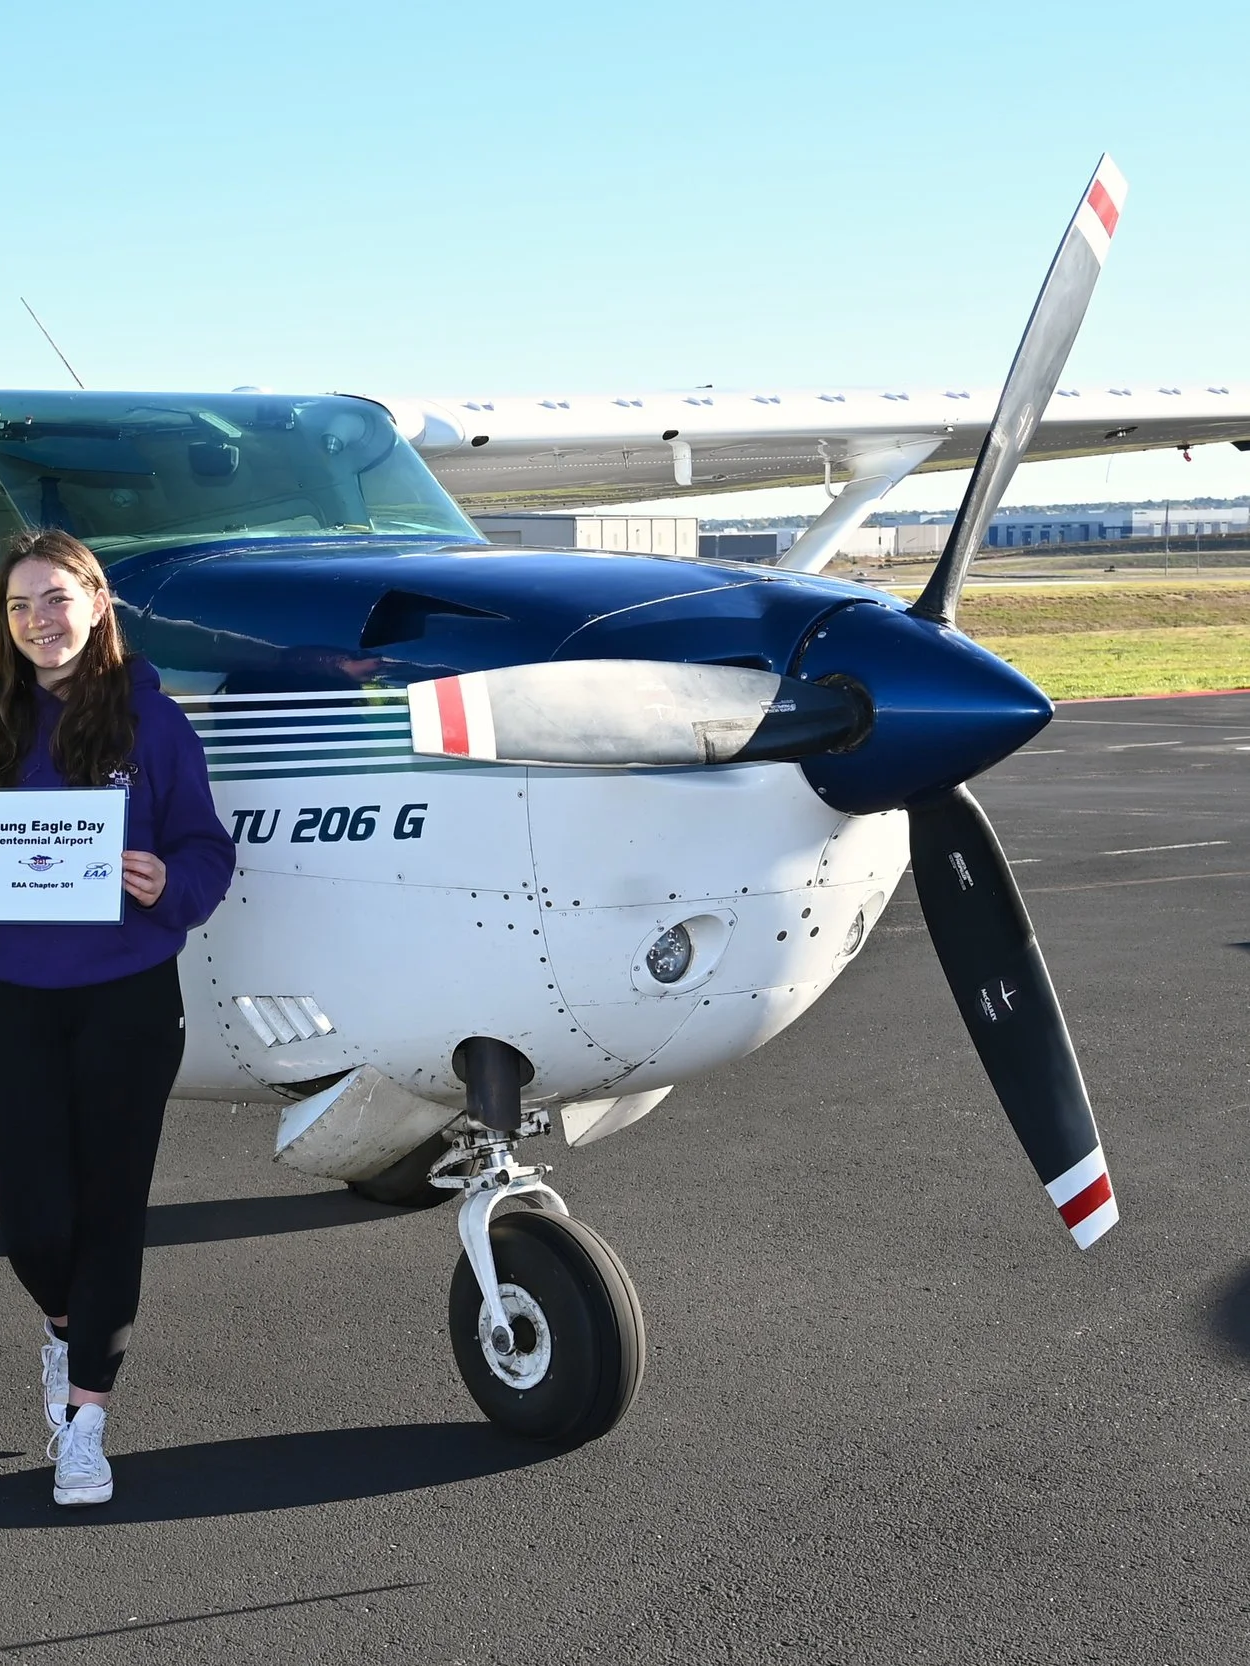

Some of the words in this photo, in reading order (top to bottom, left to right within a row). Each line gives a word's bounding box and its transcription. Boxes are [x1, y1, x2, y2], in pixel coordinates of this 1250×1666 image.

[31, 820, 73, 834] Eagle
[77, 819, 105, 834] Day
[231, 809, 281, 844] TU
[290, 805, 381, 843] 206
[393, 803, 429, 840] G
[54, 836, 93, 846] Airport
